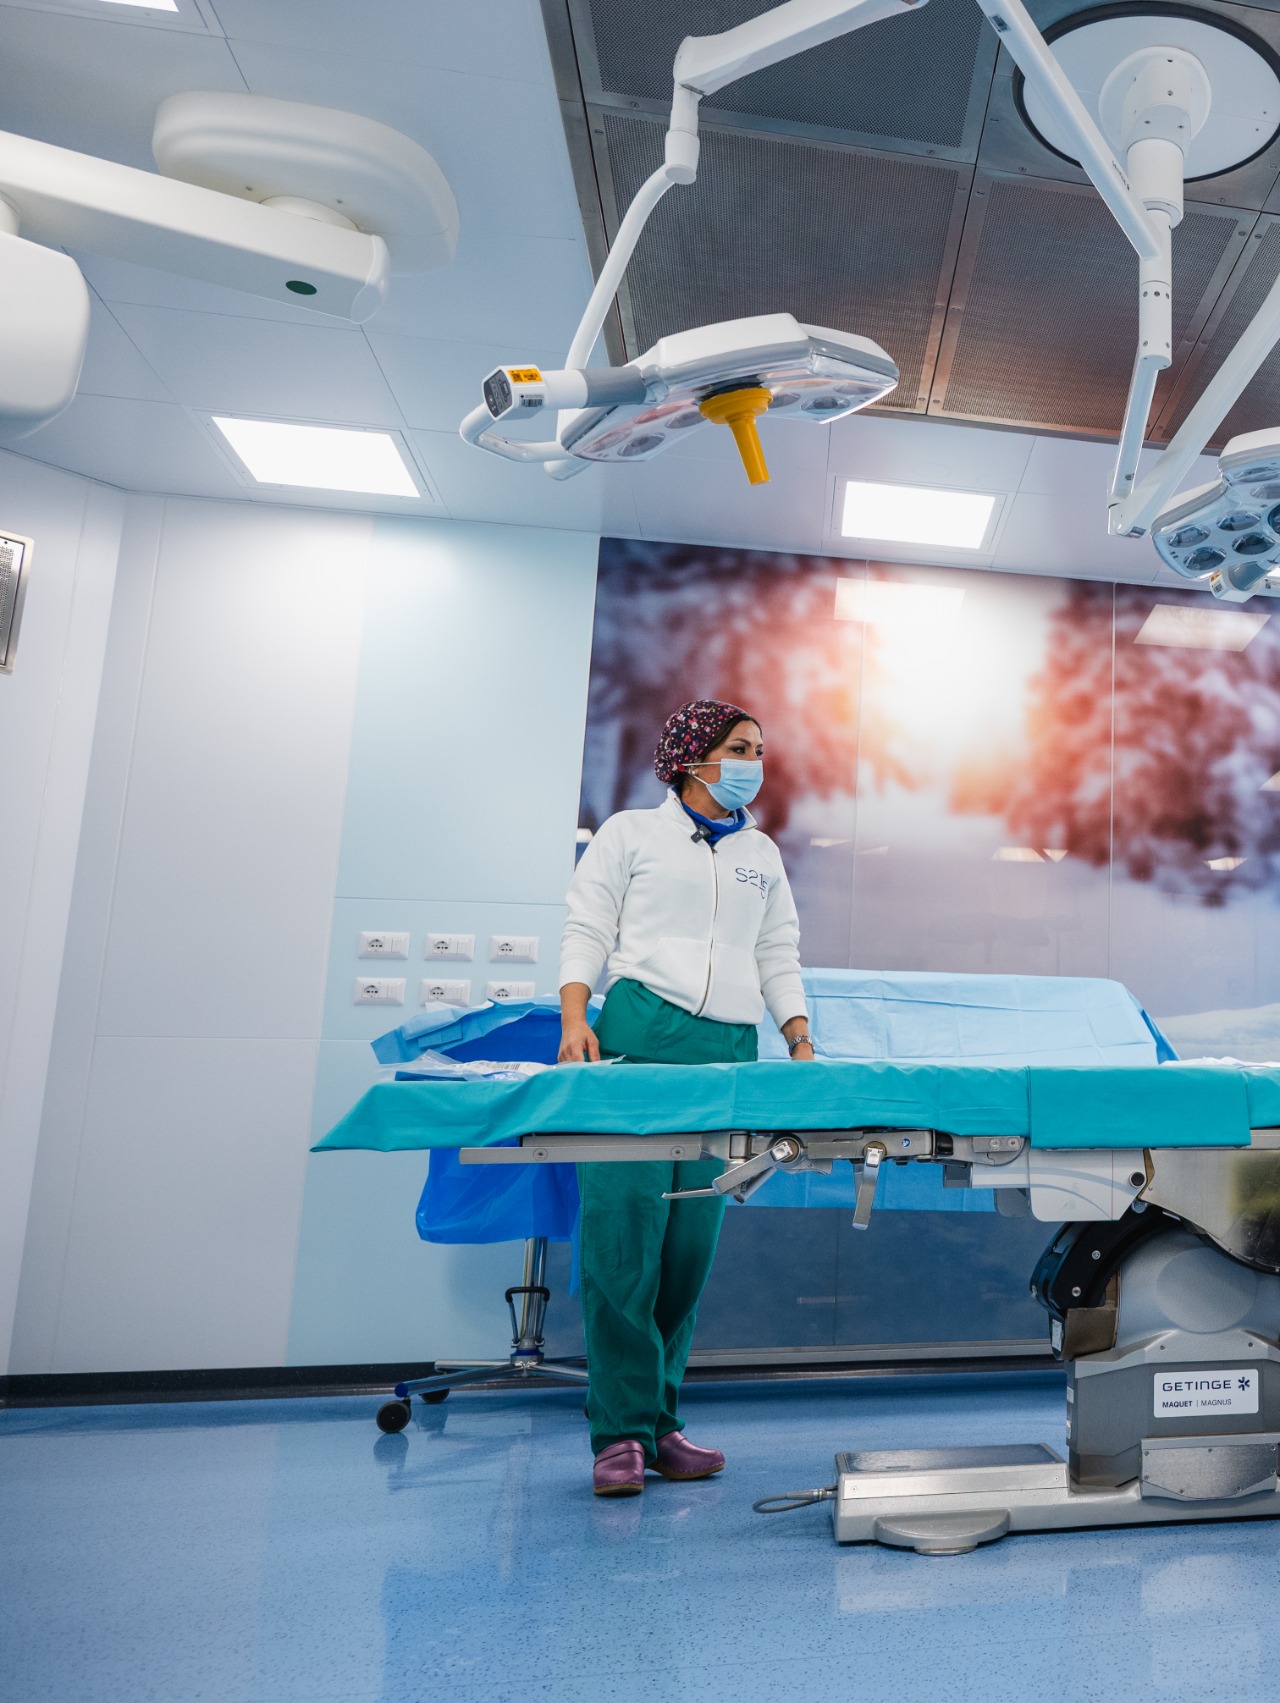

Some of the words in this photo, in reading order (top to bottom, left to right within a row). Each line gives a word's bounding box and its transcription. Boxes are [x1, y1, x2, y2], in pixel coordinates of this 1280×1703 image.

[1162, 1380, 1232, 1392] GETINGE
[1162, 1400, 1193, 1408] MAQUET
[1200, 1398, 1232, 1407] MAGNUS
